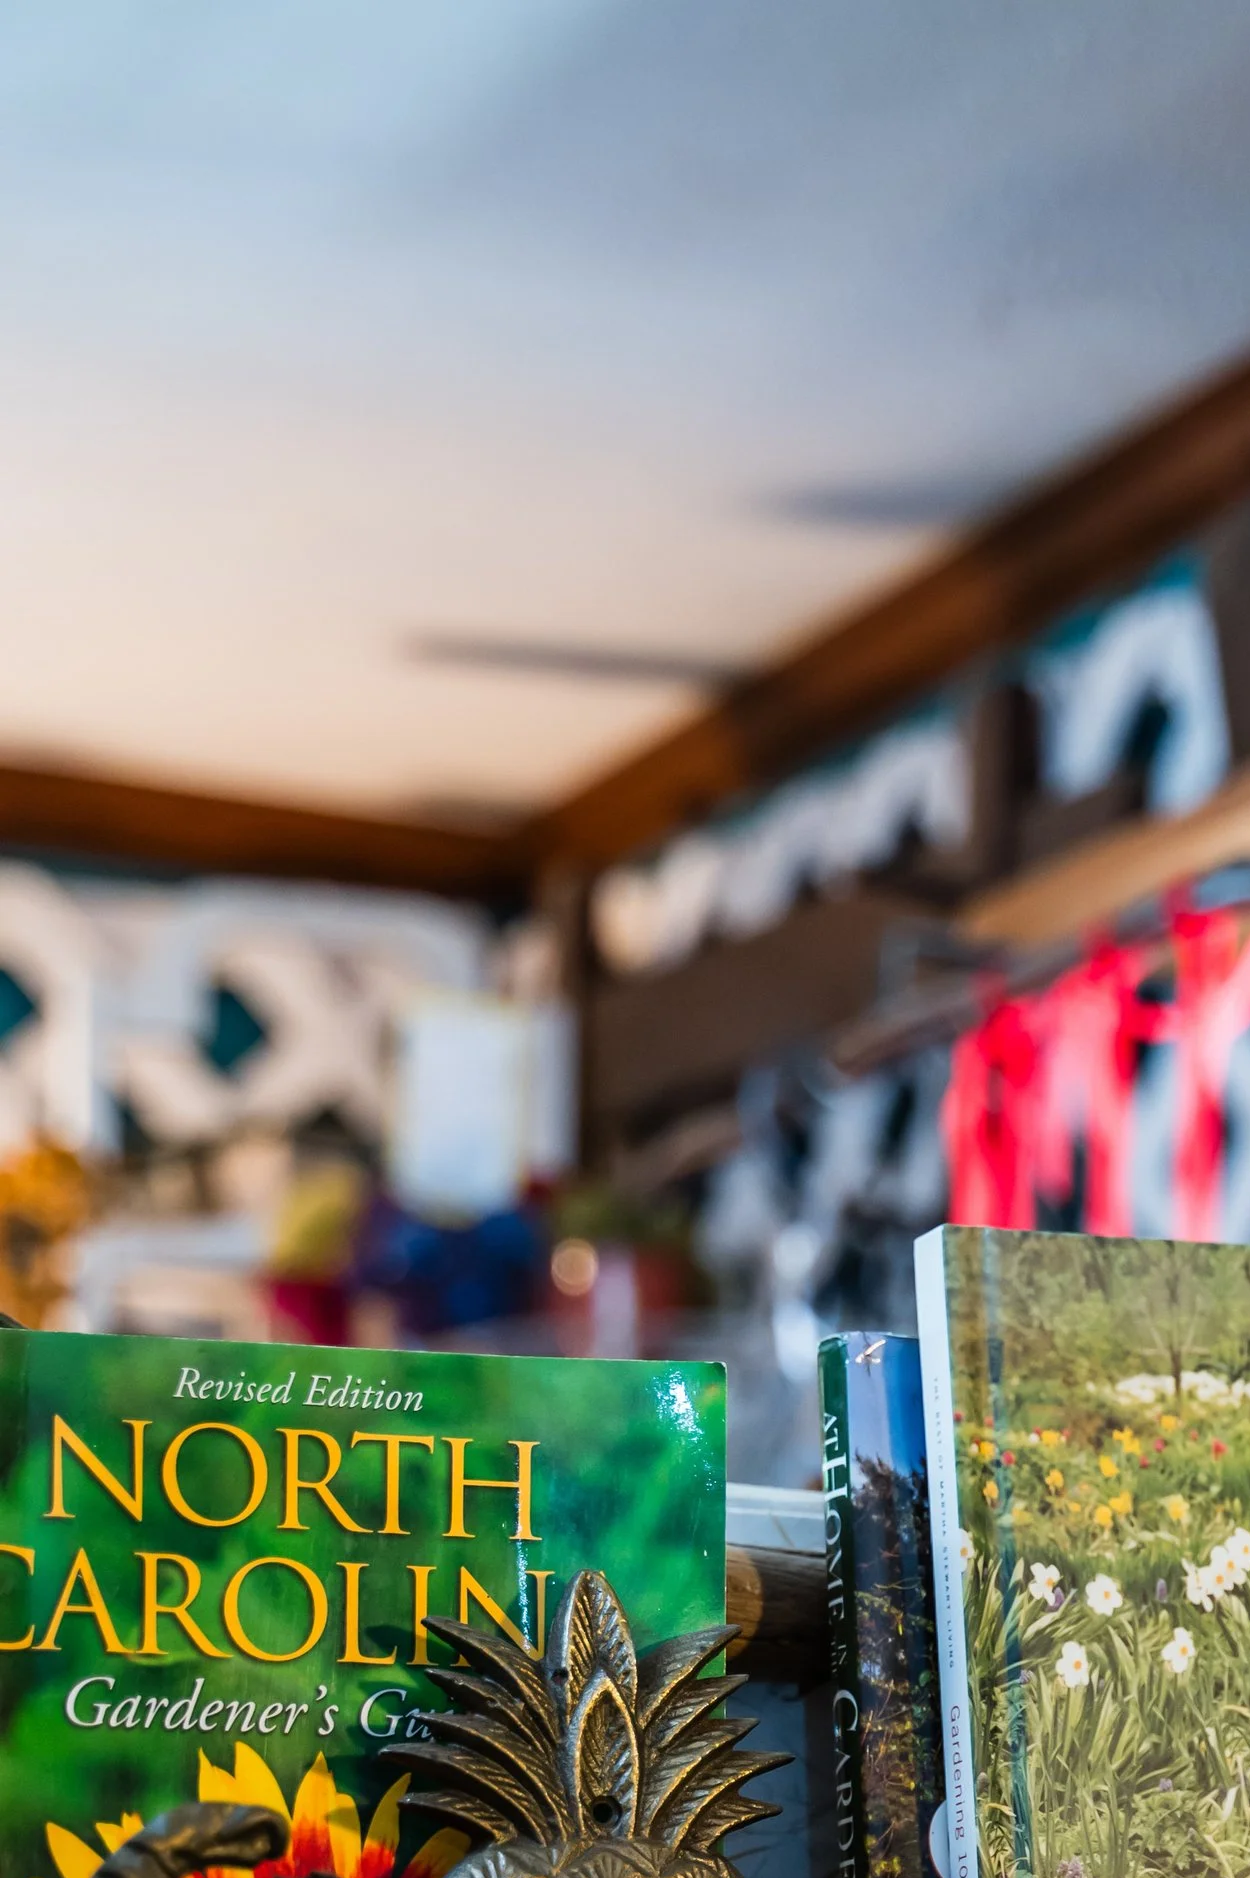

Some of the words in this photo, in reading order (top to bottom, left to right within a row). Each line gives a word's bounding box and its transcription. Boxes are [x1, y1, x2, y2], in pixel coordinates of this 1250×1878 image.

[172, 1366, 296, 1405] Revised
[302, 1374, 424, 1412] Edition
[823, 1411, 839, 1452] AT
[43, 1413, 543, 1542] NORTH
[822, 1452, 848, 1625] HOME
[0, 1543, 556, 1668] AROLIN
[64, 1675, 340, 1739] Gardener's
[950, 1704, 967, 1842] Gardening
